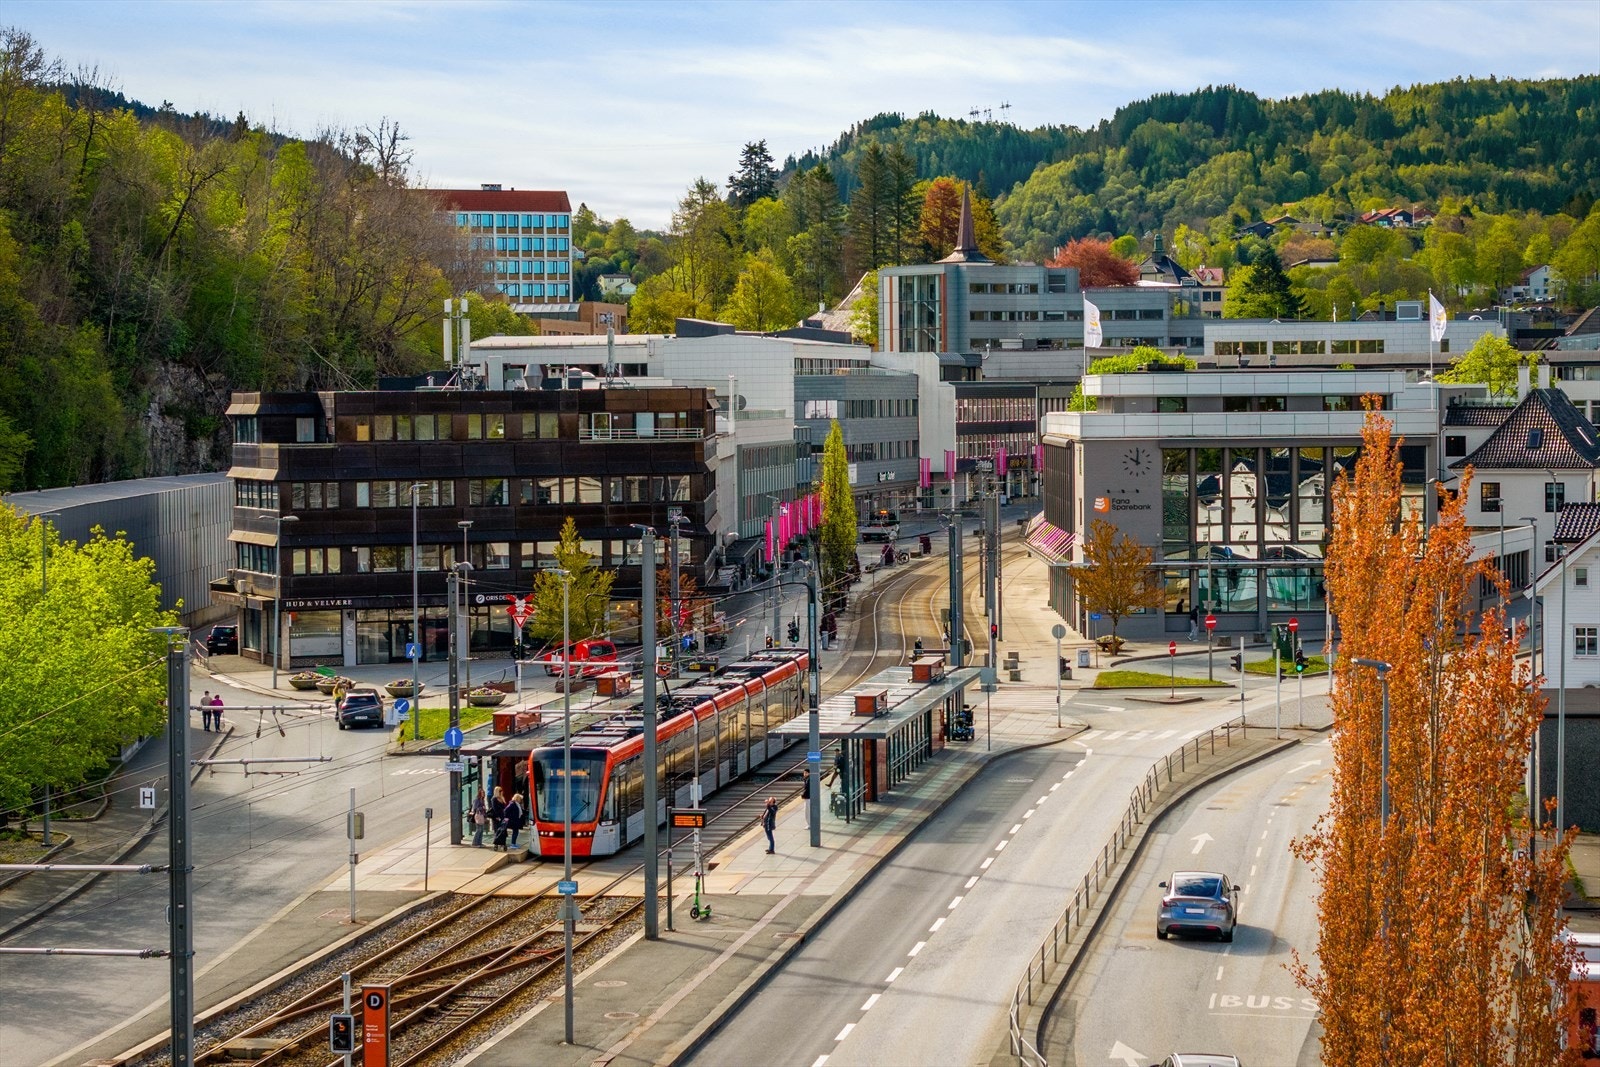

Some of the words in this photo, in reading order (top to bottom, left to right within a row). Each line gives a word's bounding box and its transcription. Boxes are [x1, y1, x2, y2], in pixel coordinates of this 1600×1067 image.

[314, 599, 353, 607] VELVÆRE
[142, 791, 153, 805] H
[370, 995, 380, 1007] D
[1220, 994, 1321, 1012] BUSS
